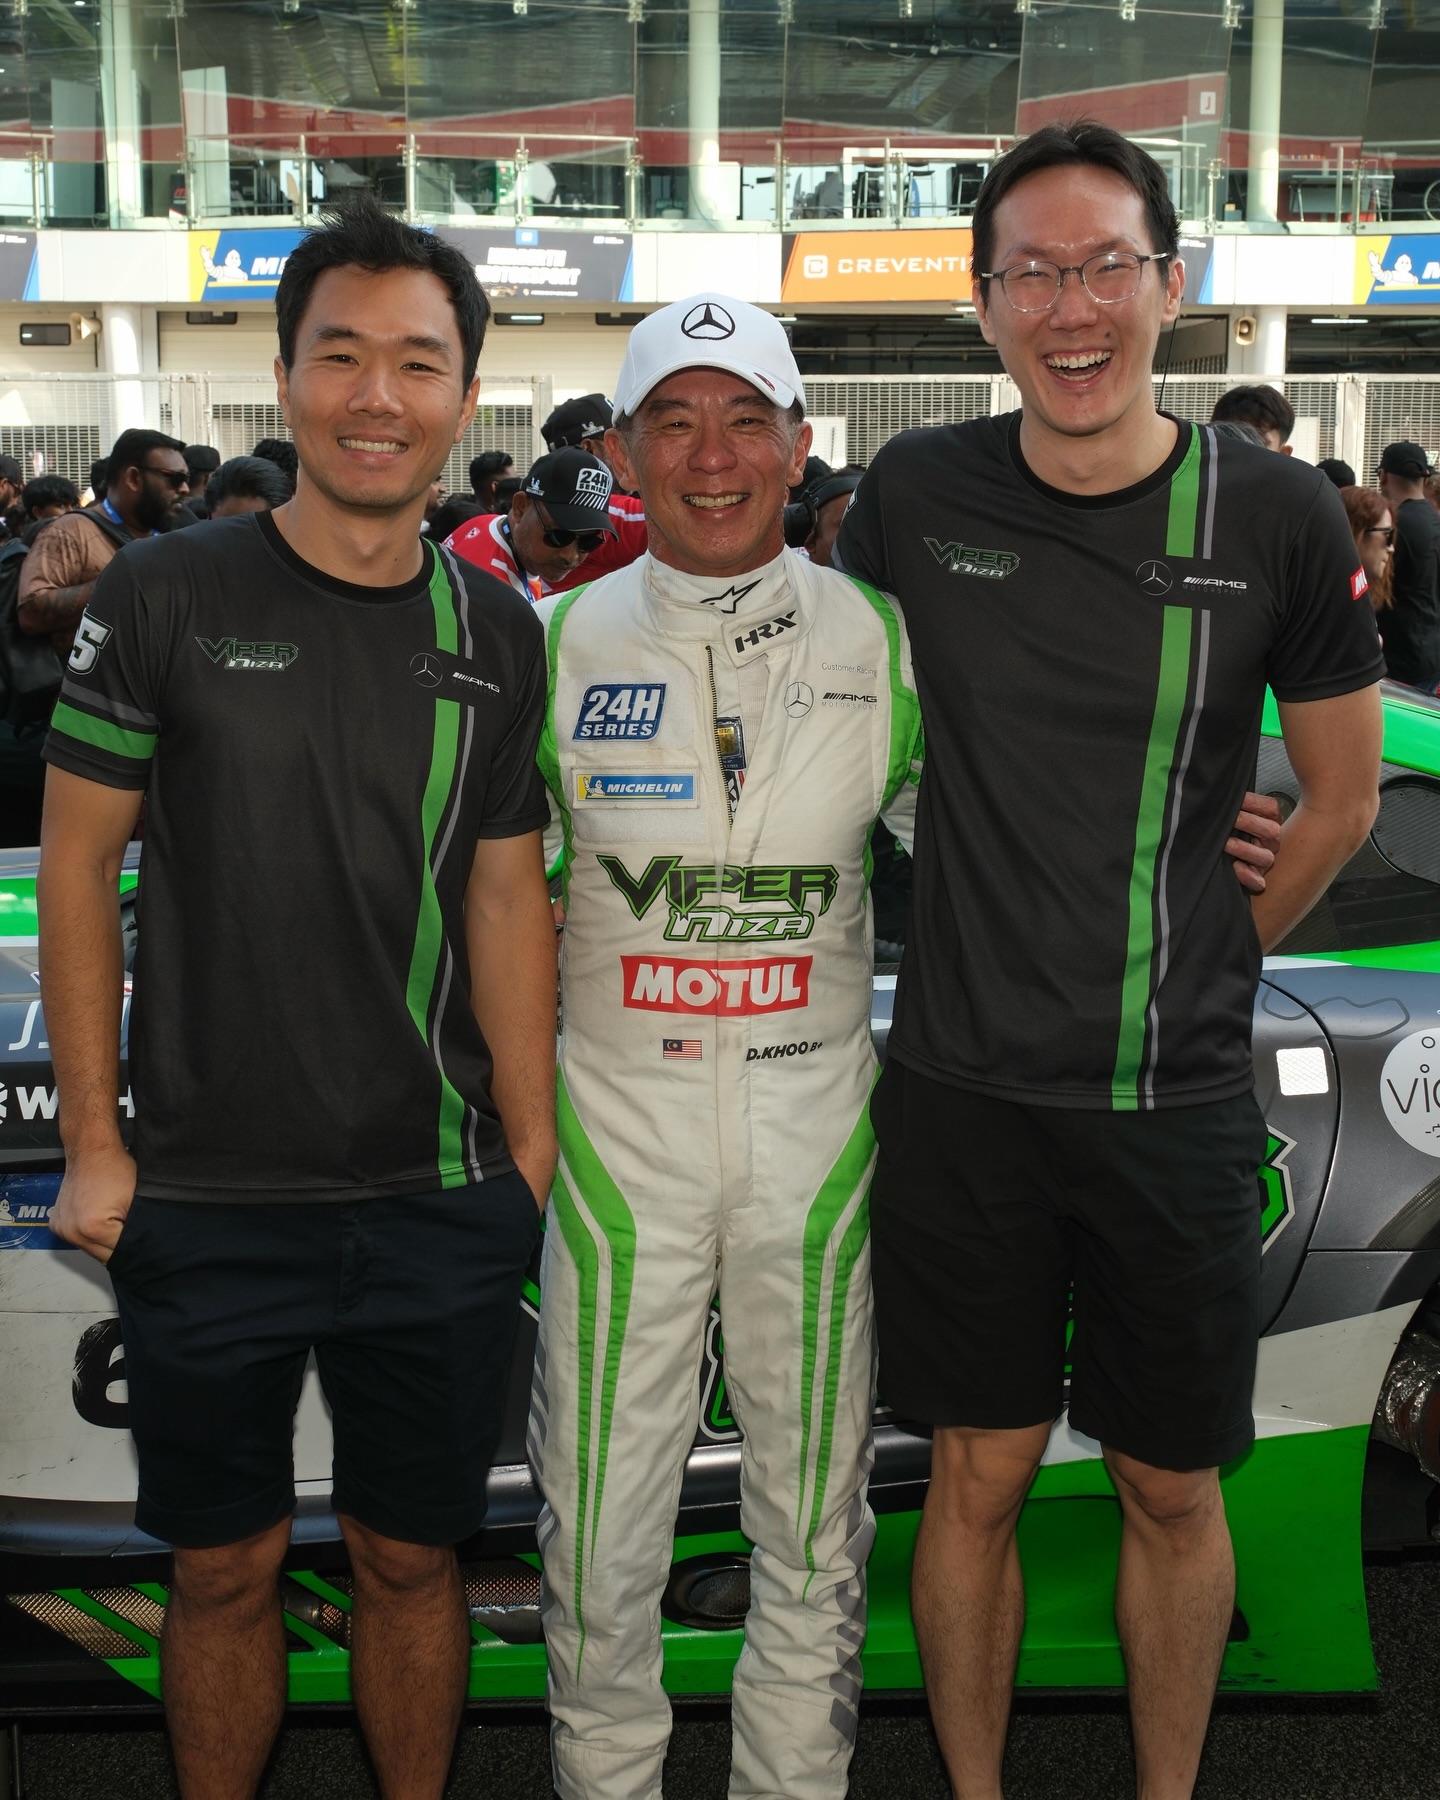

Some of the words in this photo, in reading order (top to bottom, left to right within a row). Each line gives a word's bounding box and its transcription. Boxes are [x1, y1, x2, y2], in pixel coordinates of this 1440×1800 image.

[837, 256, 973, 274] CREVENTI
[581, 470, 608, 489] 24H
[579, 483, 606, 495] SERIES
[1202, 578, 1248, 590] AMG
[734, 609, 797, 654] HRX
[821, 662, 855, 672] Customer
[584, 688, 661, 722] 24H
[840, 693, 878, 703] AMG
[580, 723, 654, 737] SERIES
[606, 782, 684, 794] MICHELIN
[596, 855, 840, 921] VIPER
[631, 963, 802, 1009] MOTUL
[745, 1041, 809, 1062] D.KHOO
